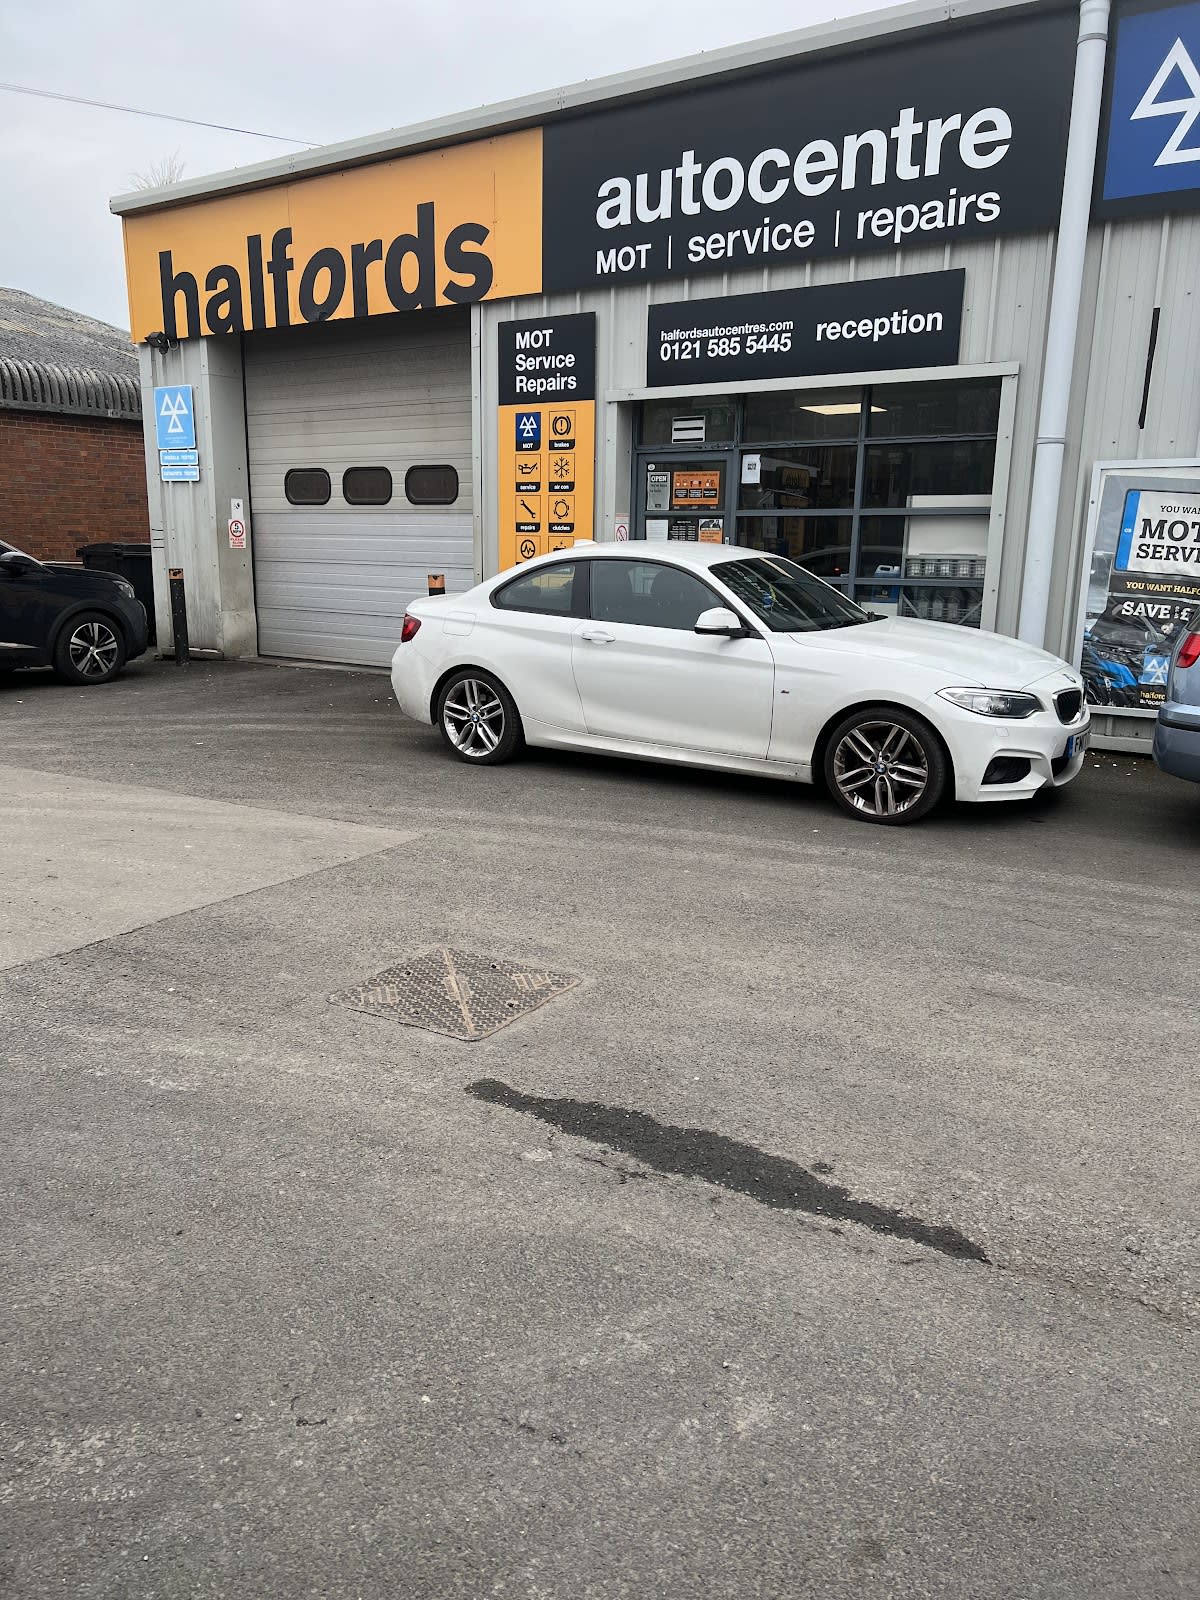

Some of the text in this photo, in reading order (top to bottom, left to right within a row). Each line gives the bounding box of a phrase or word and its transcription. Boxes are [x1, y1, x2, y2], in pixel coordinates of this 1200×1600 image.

[596, 106, 1013, 230] autocentre
[596, 188, 1001, 274] MOT service repairs
[158, 201, 494, 339] halfords
[660, 319, 794, 342] halfordsautocentres.com
[816, 310, 943, 342] reception
[515, 329, 553, 350] MOT
[660, 333, 792, 362] 0121 585 5445
[515, 353, 576, 372] Service
[515, 373, 577, 396] Repairs
[1160, 505, 1181, 514] YOU
[1125, 581, 1145, 590] YOU
[1146, 583, 1173, 592] WANT
[1121, 600, 1172, 620] SAVE
